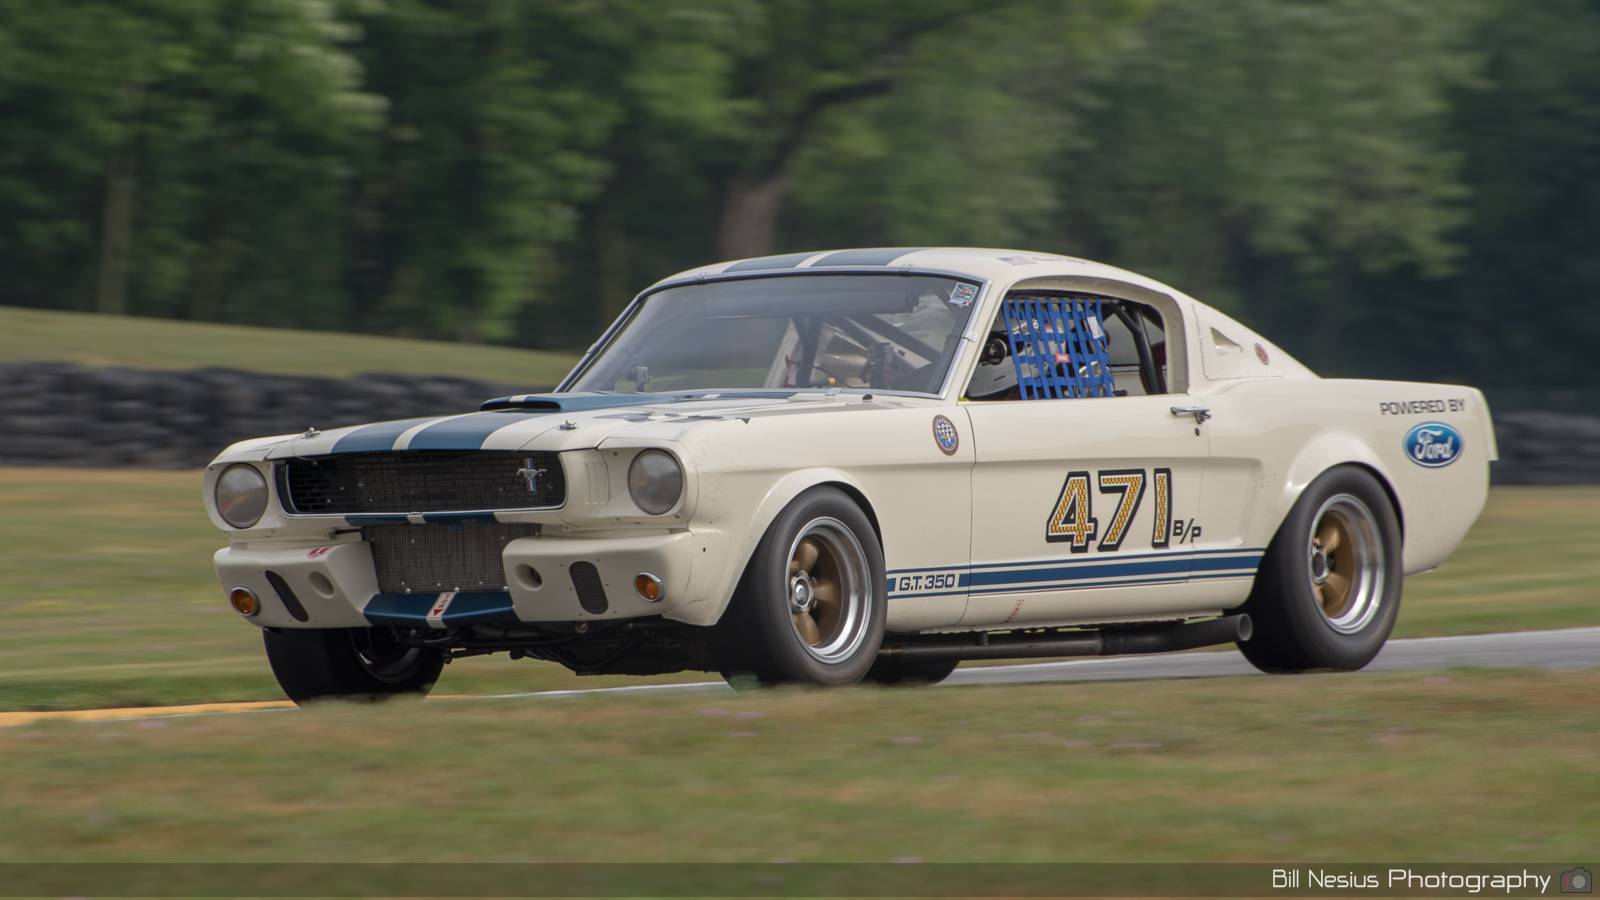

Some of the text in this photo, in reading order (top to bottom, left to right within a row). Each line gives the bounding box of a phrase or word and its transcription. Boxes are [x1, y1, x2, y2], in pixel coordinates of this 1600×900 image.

[1379, 398, 1465, 415] POWERED BY
[1414, 428, 1455, 460] Ford
[1045, 467, 1172, 554] 471
[1172, 518, 1202, 544] B/P
